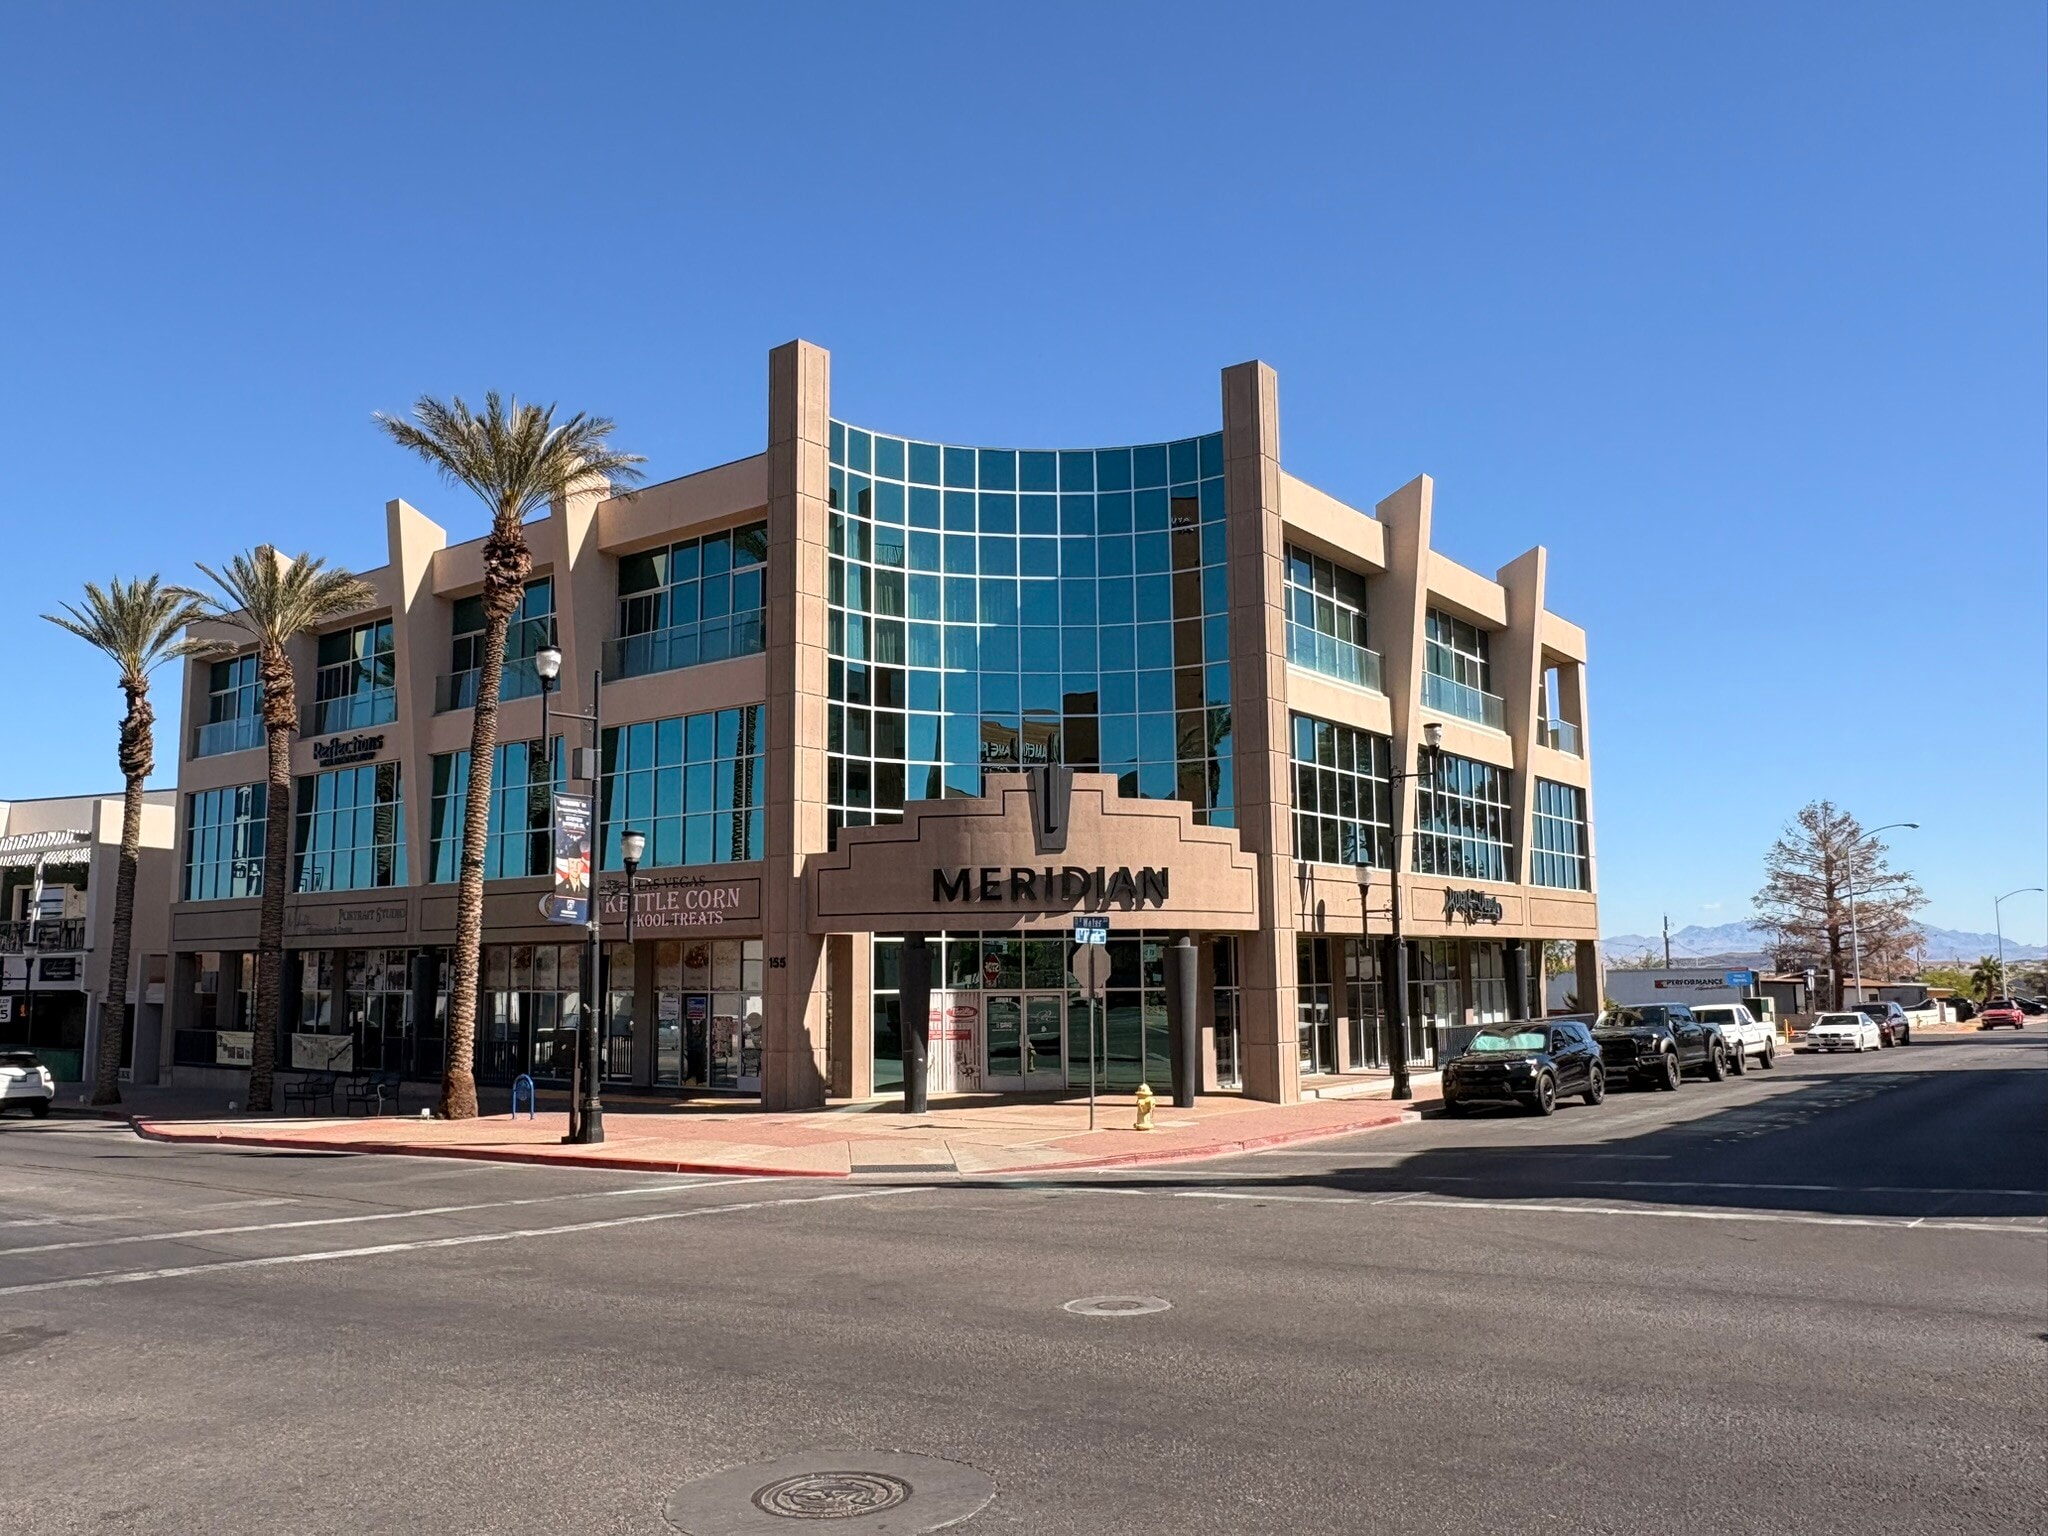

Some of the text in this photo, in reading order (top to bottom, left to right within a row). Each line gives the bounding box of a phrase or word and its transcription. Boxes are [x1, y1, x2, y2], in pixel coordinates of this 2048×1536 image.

[313, 734, 384, 759] Reflections
[663, 875, 706, 889] VEGAS
[932, 866, 1169, 902] MERIDIAN
[605, 887, 740, 914] KETTLE CORN
[637, 913, 669, 928] KOOL
[672, 910, 724, 926] TREATS
[769, 956, 787, 969] 155
[1666, 978, 1723, 986] PERFORMANCE
